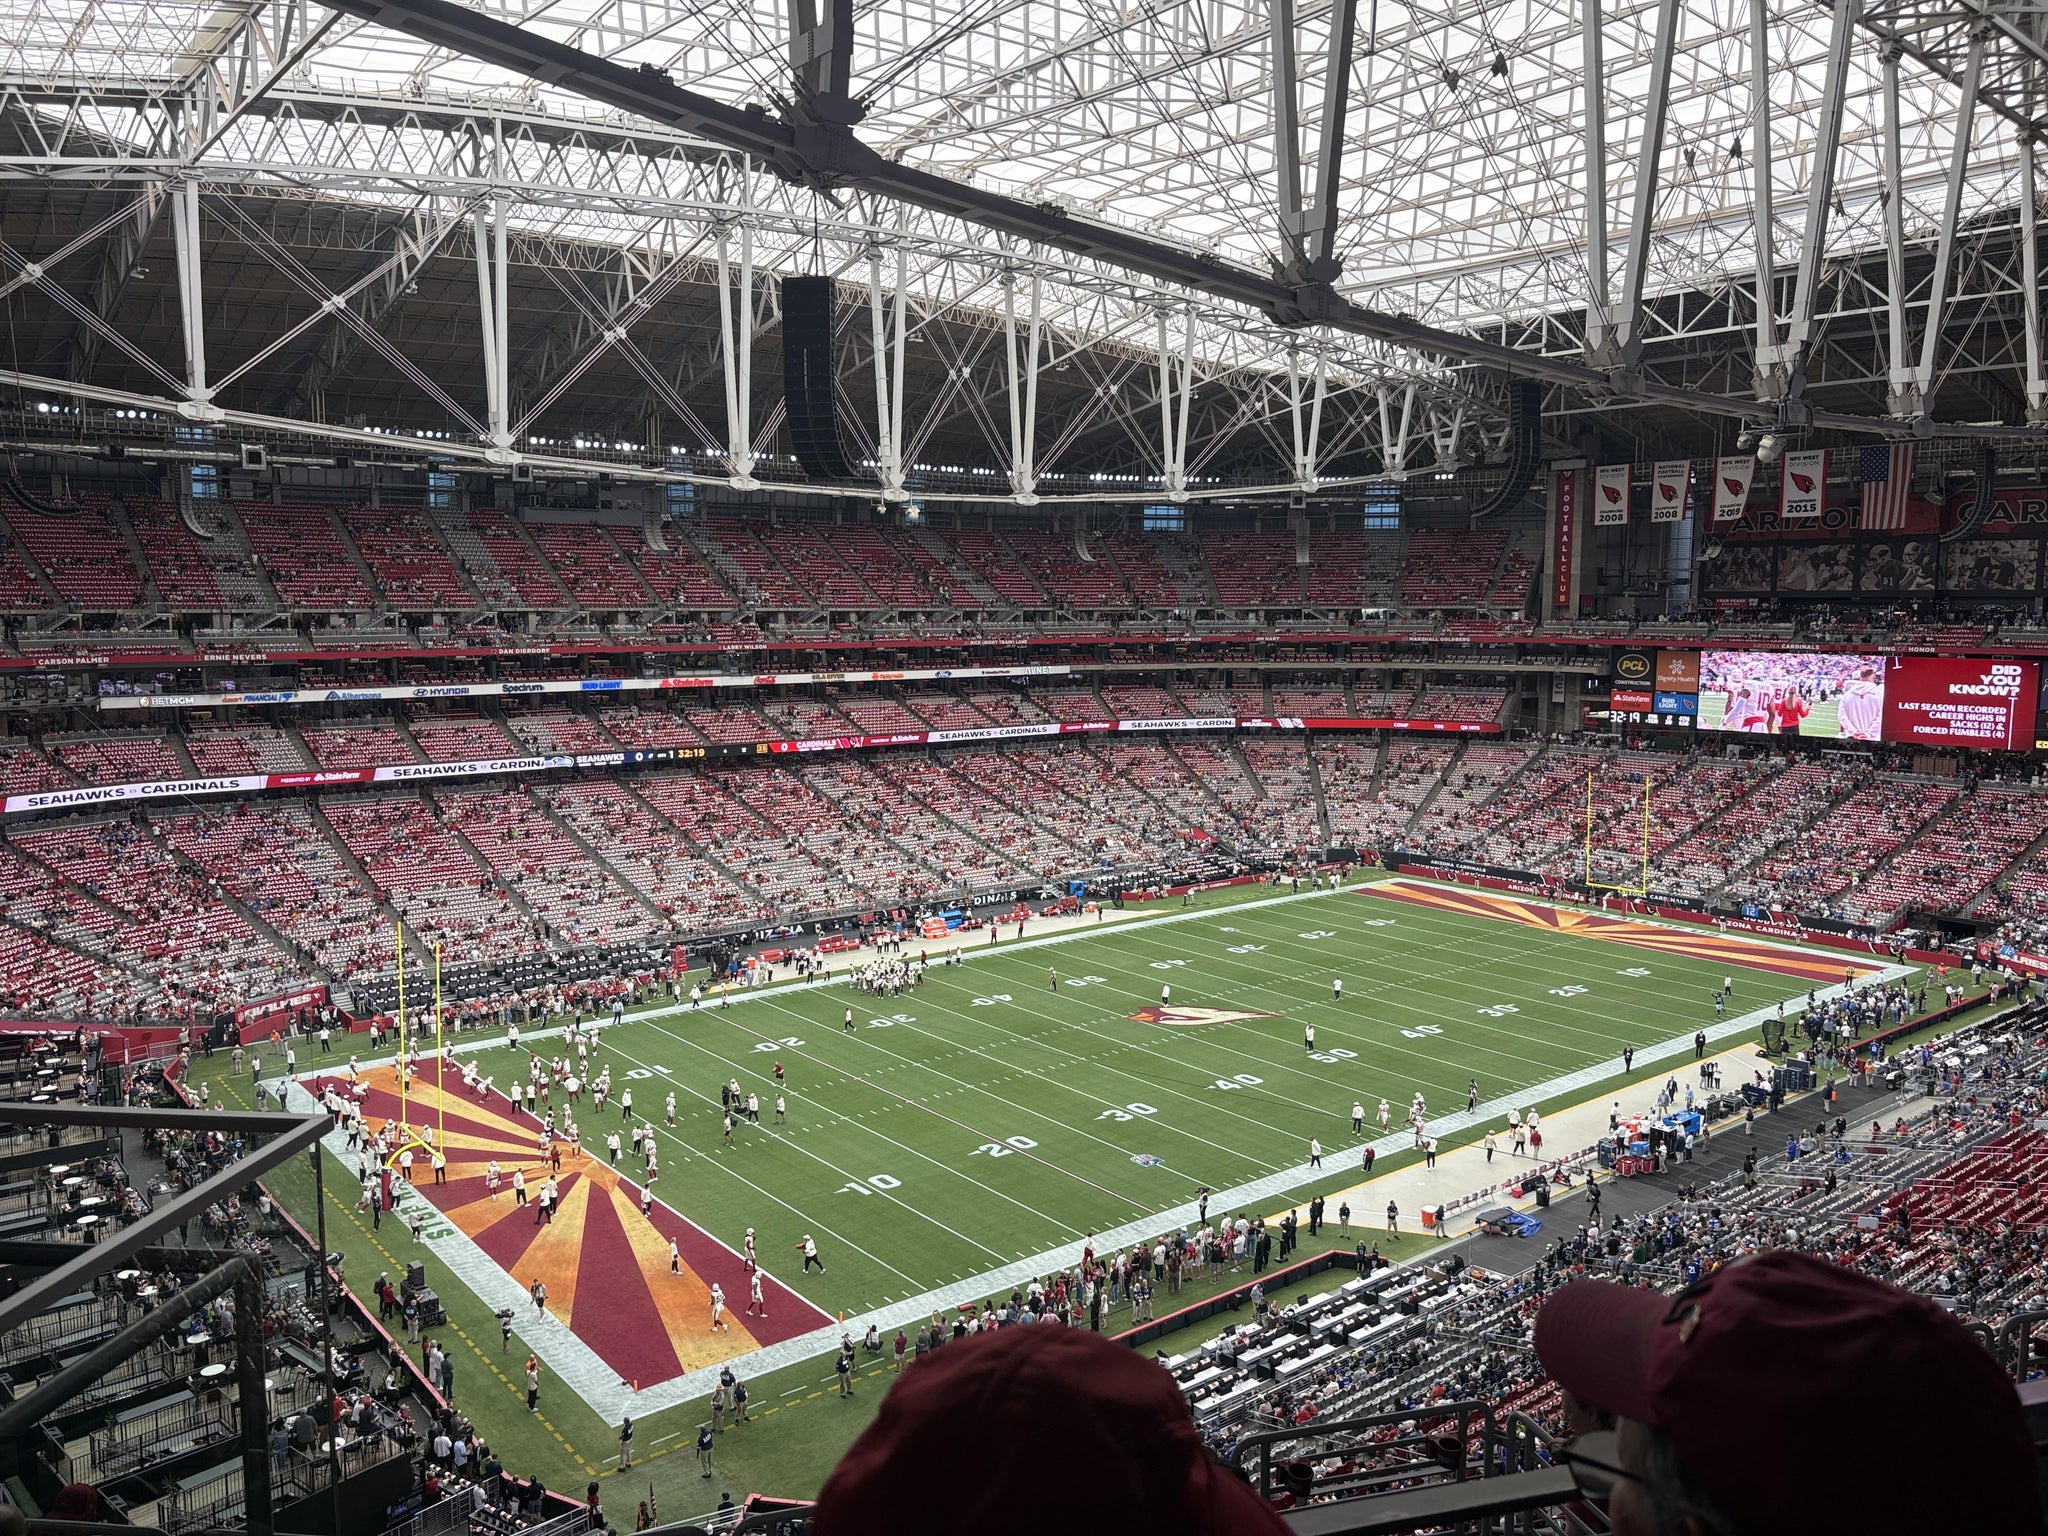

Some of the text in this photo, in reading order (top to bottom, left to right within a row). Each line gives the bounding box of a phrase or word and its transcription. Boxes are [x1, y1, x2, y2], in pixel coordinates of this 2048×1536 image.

[1721, 464, 1750, 472] DIVISION
[1789, 460, 1819, 468] DIVISION
[1786, 503, 1817, 513] 2015
[1598, 513, 1624, 522] 2008
[1653, 511, 1678, 519] 2008
[1561, 485, 1570, 562] FOOTBALL
[1559, 565, 1567, 602] CLUB
[38, 658, 74, 666] CARSON
[75, 657, 110, 665] PALMER
[1622, 660, 1645, 671] PCL
[1991, 665, 2022, 675] DID
[1657, 675, 1676, 683] Dignity
[1980, 675, 2021, 685] YOU
[430, 688, 470, 696] HYUNDAI
[502, 684, 543, 694] Spectrum
[1948, 684, 2021, 697] KNOW?
[152, 697, 194, 705] BETMGM
[244, 694, 278, 703] FINANCIAL
[342, 693, 382, 701] Albertsons
[1757, 692, 1770, 711] 10
[1898, 702, 2007, 714] LAST SEASON RECORDED
[1610, 711, 1641, 723] 32:19
[1929, 711, 2006, 722] CAREER HIGHS IN
[1950, 719, 1979, 728] SACKS
[1996, 722, 2005, 730] &
[939, 727, 1048, 740] SEAHAWKS CARDINALS
[1913, 726, 2005, 739] FORCED FUMBLES (4)
[781, 740, 836, 752] 0 CARDINALS
[576, 753, 644, 763] SEAHAWKS 0
[678, 749, 705, 759] 32:19
[393, 764, 477, 777] SEAHAWKS
[29, 788, 126, 807] SEAHAWKS
[141, 780, 240, 794] CARDINALS
[1430, 859, 1487, 873] ARIZONA CARDINALS
[949, 892, 1018, 908] CDINALS
[1649, 894, 1689, 905] CARDNALS
[1746, 907, 1756, 916] 12
[1711, 918, 1808, 939] AZONA CARDINAS
[1064, 975, 1109, 987] 50
[1547, 985, 1589, 997] 20
[971, 994, 1013, 1006] 40
[1476, 1004, 1520, 1017] 30
[869, 1014, 917, 1028] 30
[1399, 1025, 1444, 1039] 40
[754, 1036, 806, 1052] 20
[1307, 1048, 1359, 1063] 50
[626, 1064, 673, 1080] 10
[1214, 1073, 1264, 1090] 40
[1102, 1102, 1158, 1122] 30
[978, 1135, 1039, 1158] 20
[844, 1174, 903, 1196] 10
[1688, 1265, 1696, 1274] 21
